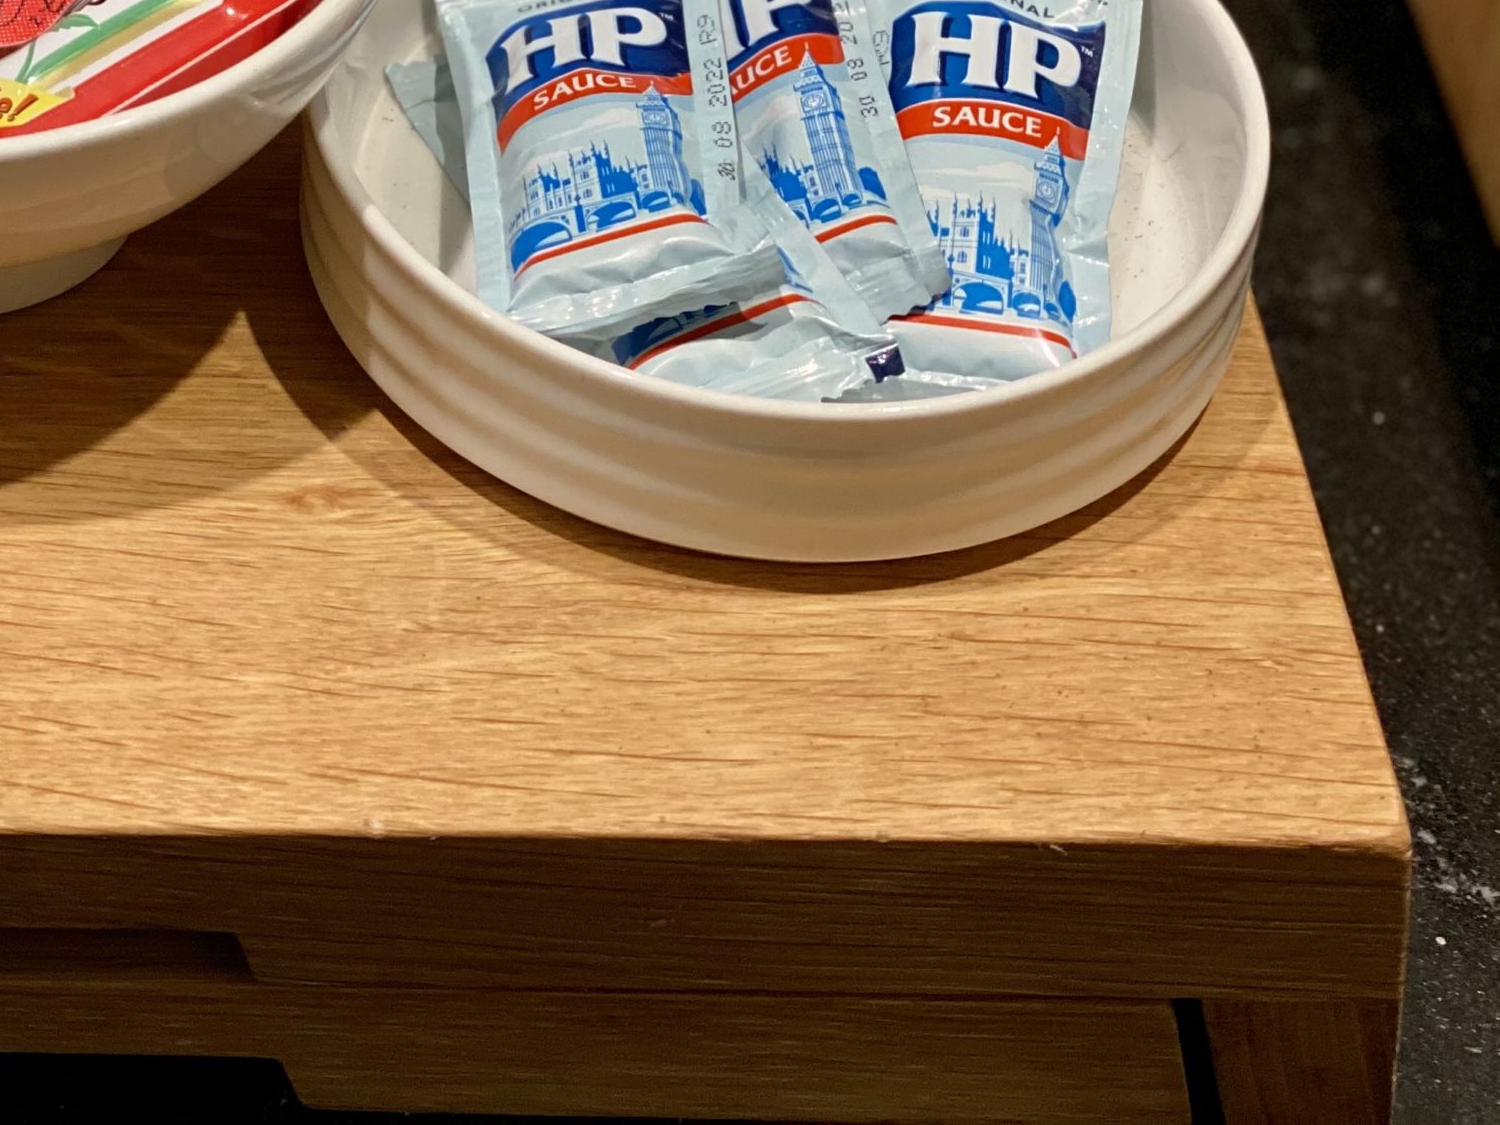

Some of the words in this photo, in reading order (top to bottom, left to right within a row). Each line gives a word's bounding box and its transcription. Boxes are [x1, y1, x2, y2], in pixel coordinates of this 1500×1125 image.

[499, 7, 668, 96] HP
[731, 45, 792, 96] UCE
[903, 11, 1082, 99] HP
[532, 73, 637, 111] SAUCE
[703, 56, 728, 107] 2022
[932, 106, 1042, 138] SAUCE
